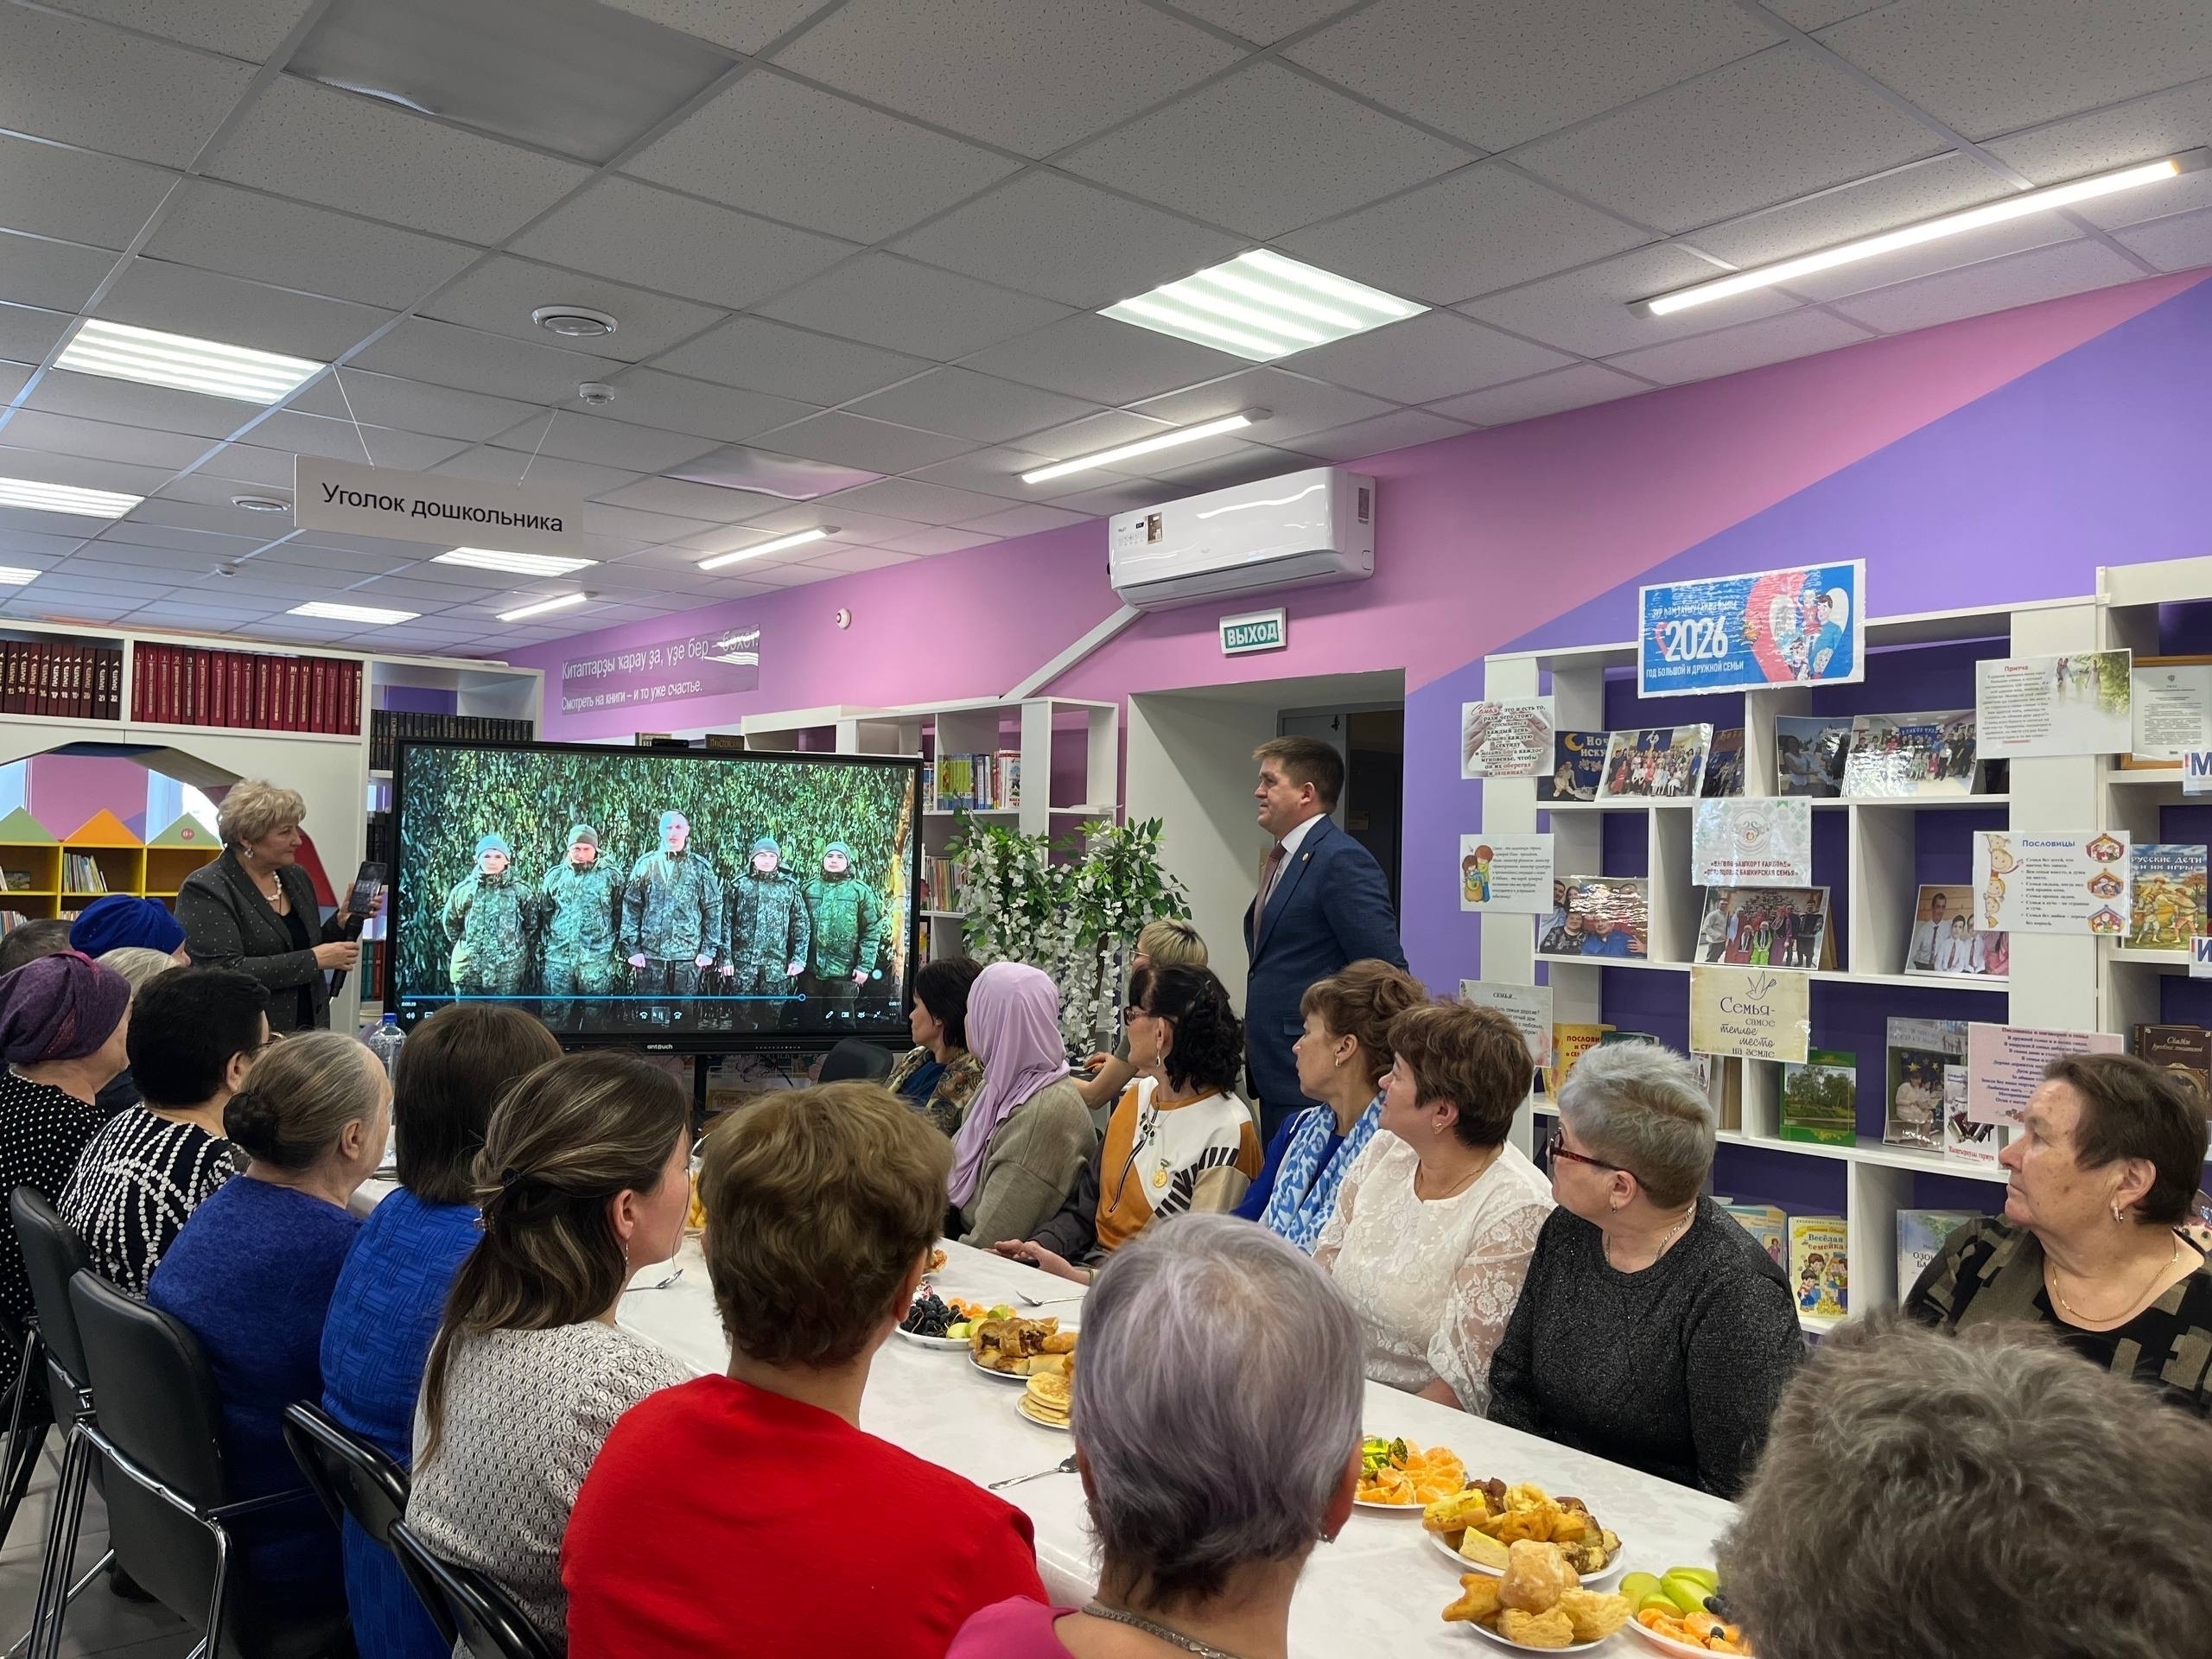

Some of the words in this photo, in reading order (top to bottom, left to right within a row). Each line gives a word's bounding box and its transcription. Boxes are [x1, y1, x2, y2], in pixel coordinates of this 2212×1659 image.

[321, 482, 405, 512] Уголок
[411, 499, 563, 532] дошкольника
[1226, 621, 1279, 647] ВЫХОД
[1665, 614, 1729, 663] 2026
[688, 638, 709, 661] бер
[1645, 668, 1658, 679] ГОД
[1657, 664, 1686, 677] БОЛЬШОЙ
[1686, 665, 1692, 675] И
[1691, 660, 1723, 677] ДРУЖНОЙ
[1723, 660, 1745, 672] СЕМЬИ
[562, 693, 594, 711] Смотреть
[595, 694, 604, 707] на
[606, 690, 626, 705] книги
[633, 690, 639, 702] и
[640, 688, 649, 700] то
[651, 685, 666, 702] уже
[667, 678, 703, 696] счастье.
[182, 830, 192, 838] 0+
[1720, 996, 1776, 1015] Семья-
[1745, 1018, 1776, 1027] самое
[1739, 1037, 1775, 1047] место
[1732, 1047, 1742, 1056] на
[1746, 1048, 1775, 1058] земле
